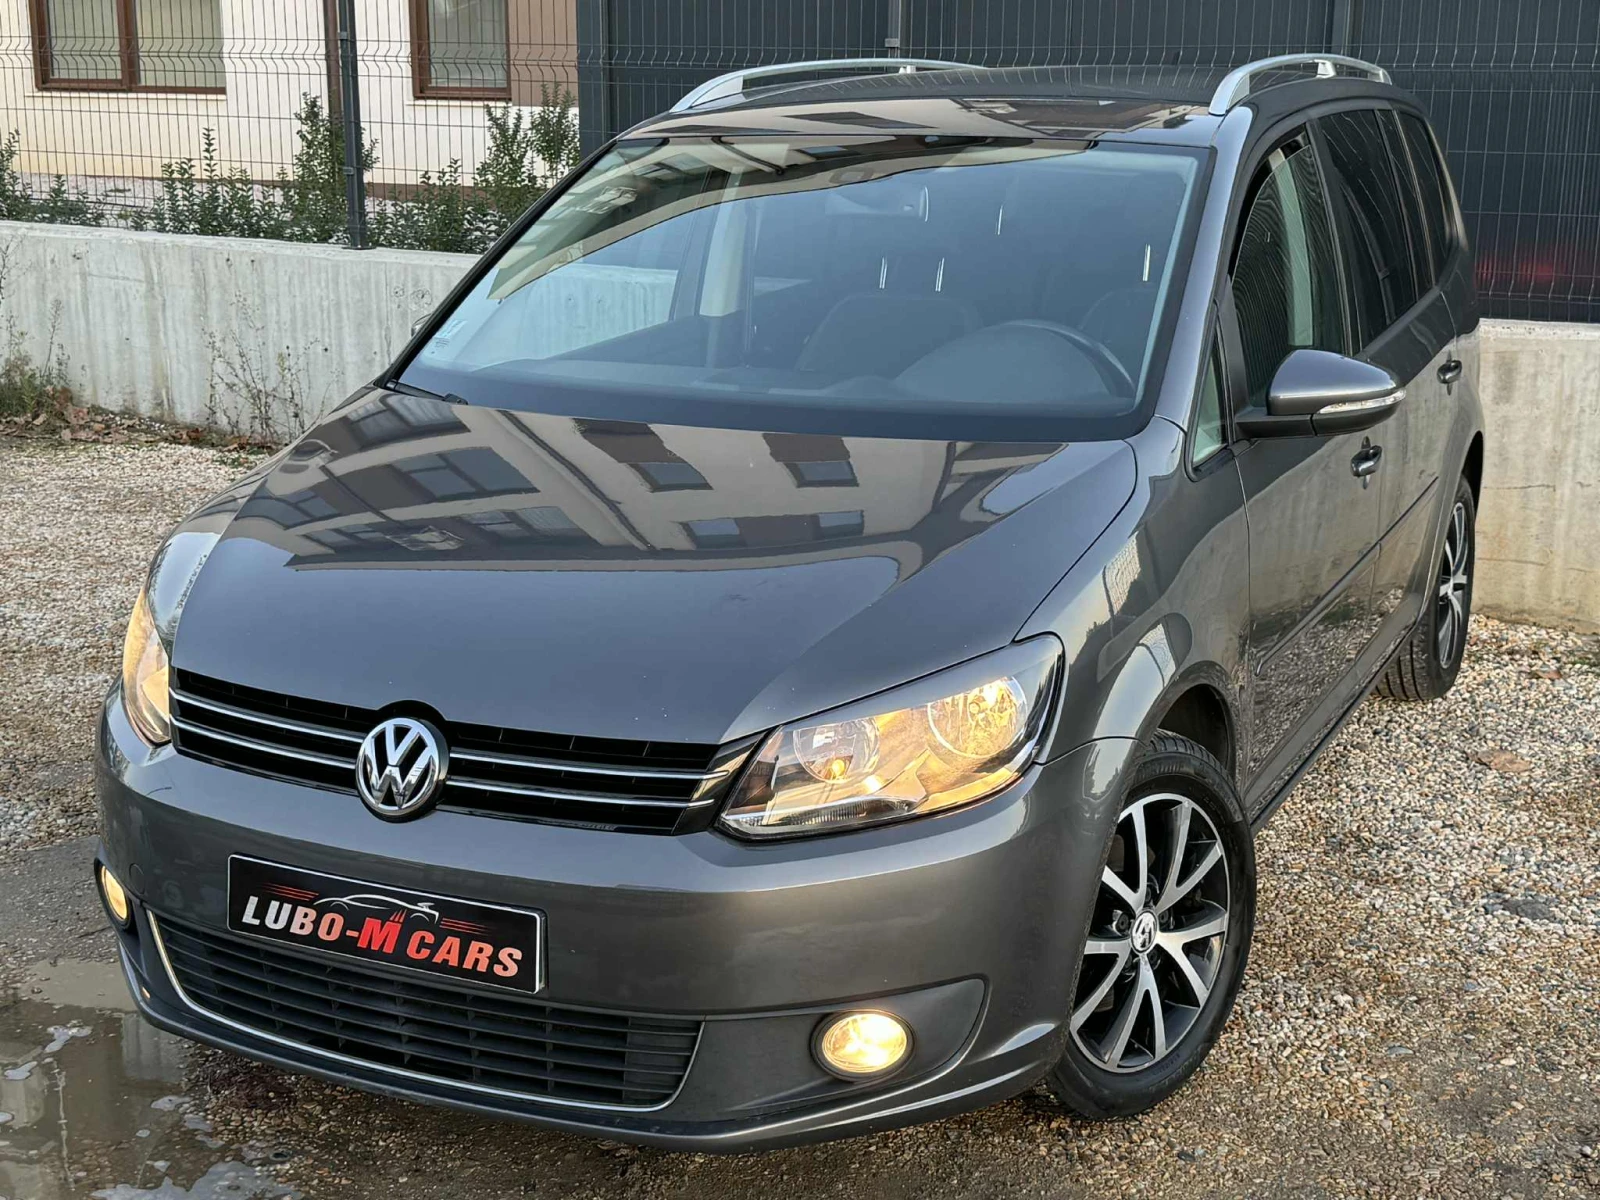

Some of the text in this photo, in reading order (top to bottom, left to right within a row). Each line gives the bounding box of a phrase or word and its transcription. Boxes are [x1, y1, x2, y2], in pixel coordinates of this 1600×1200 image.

[357, 718, 439, 814] VW
[242, 896, 523, 977] LUBO-M CARS
